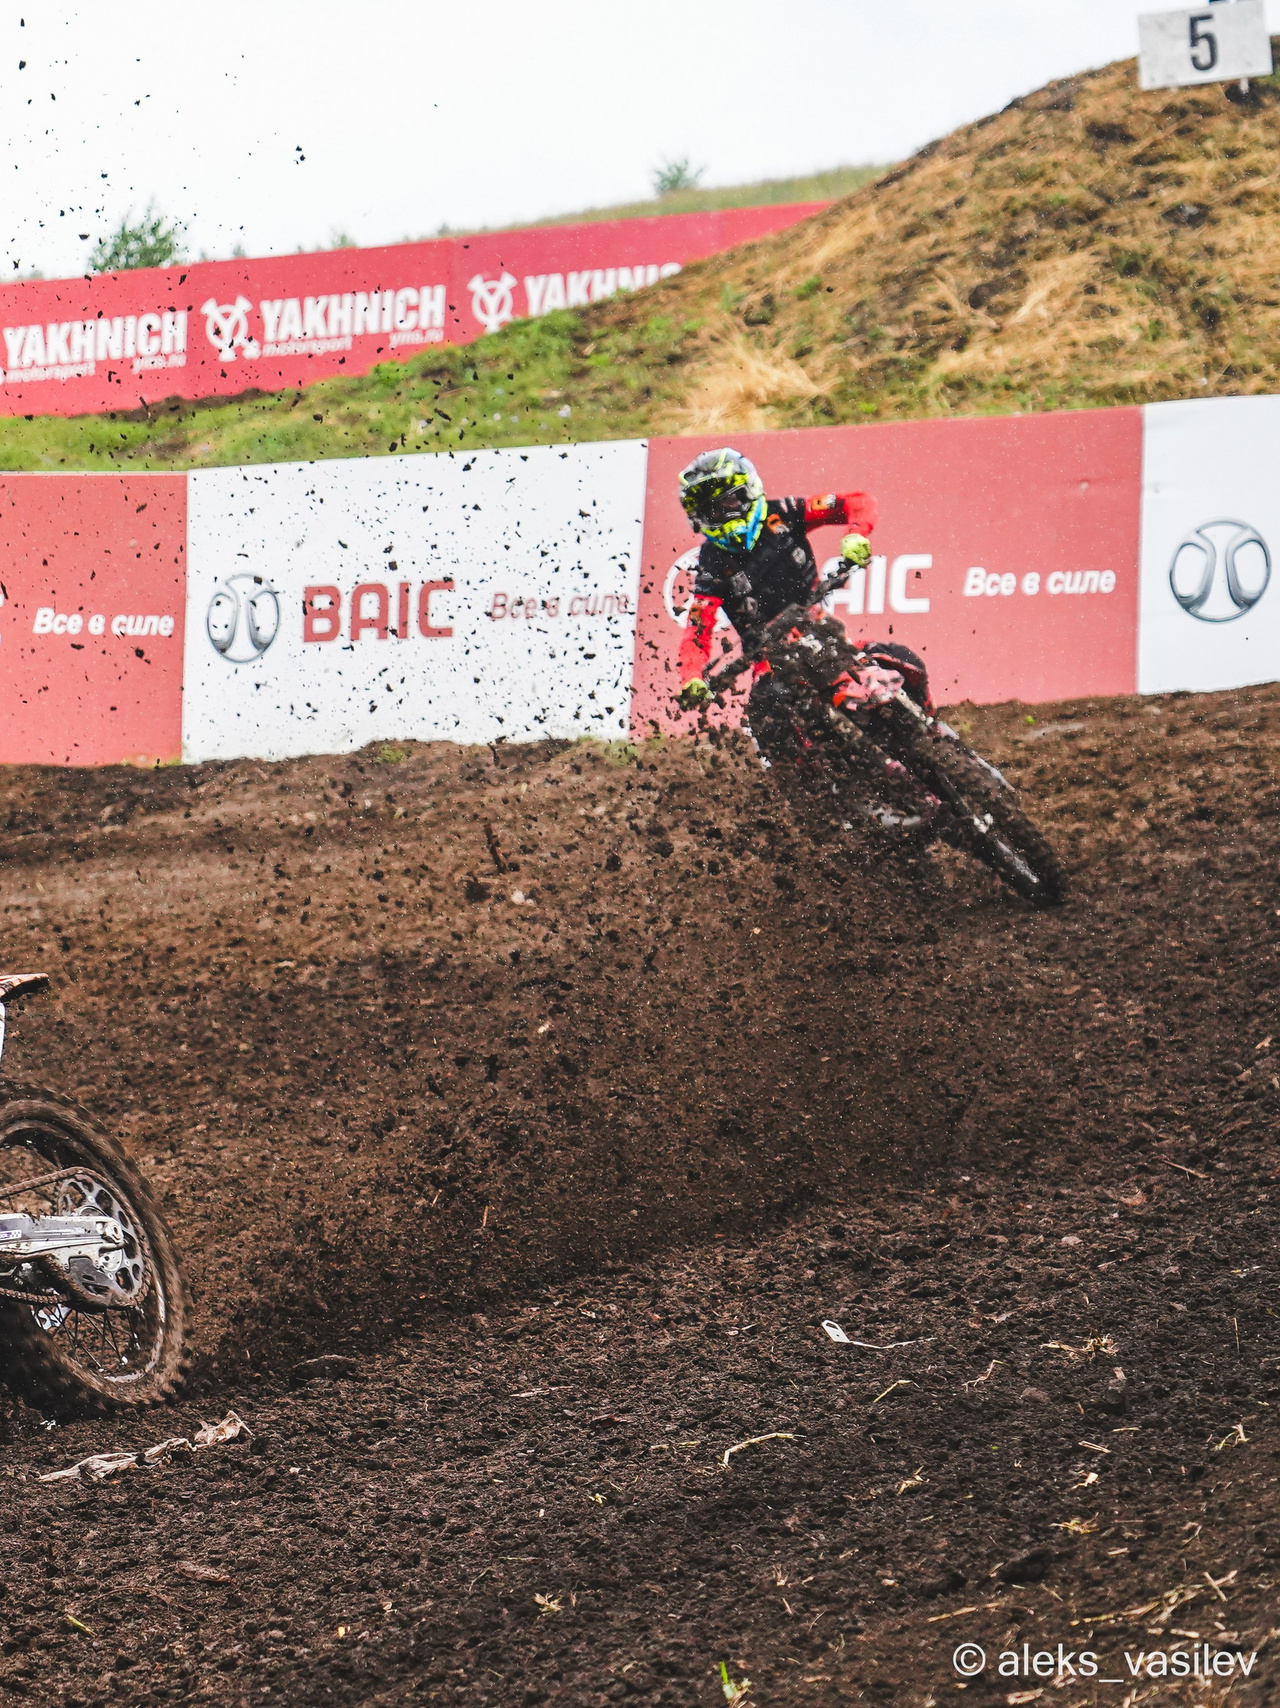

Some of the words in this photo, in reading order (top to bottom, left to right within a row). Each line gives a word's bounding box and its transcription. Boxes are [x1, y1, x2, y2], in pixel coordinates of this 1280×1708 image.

[1189, 14, 1218, 71] 5
[260, 284, 446, 342] YAKHNICH
[524, 262, 683, 317] YAKHN
[2, 310, 188, 369] YAKHNICH
[822, 553, 932, 614] AIC
[964, 566, 1017, 597] Все
[1022, 571, 1041, 595] в
[1045, 568, 1117, 594] силе
[33, 607, 83, 635] Все
[88, 614, 105, 635] в
[111, 614, 175, 637] силе
[303, 580, 455, 643] BAIC
